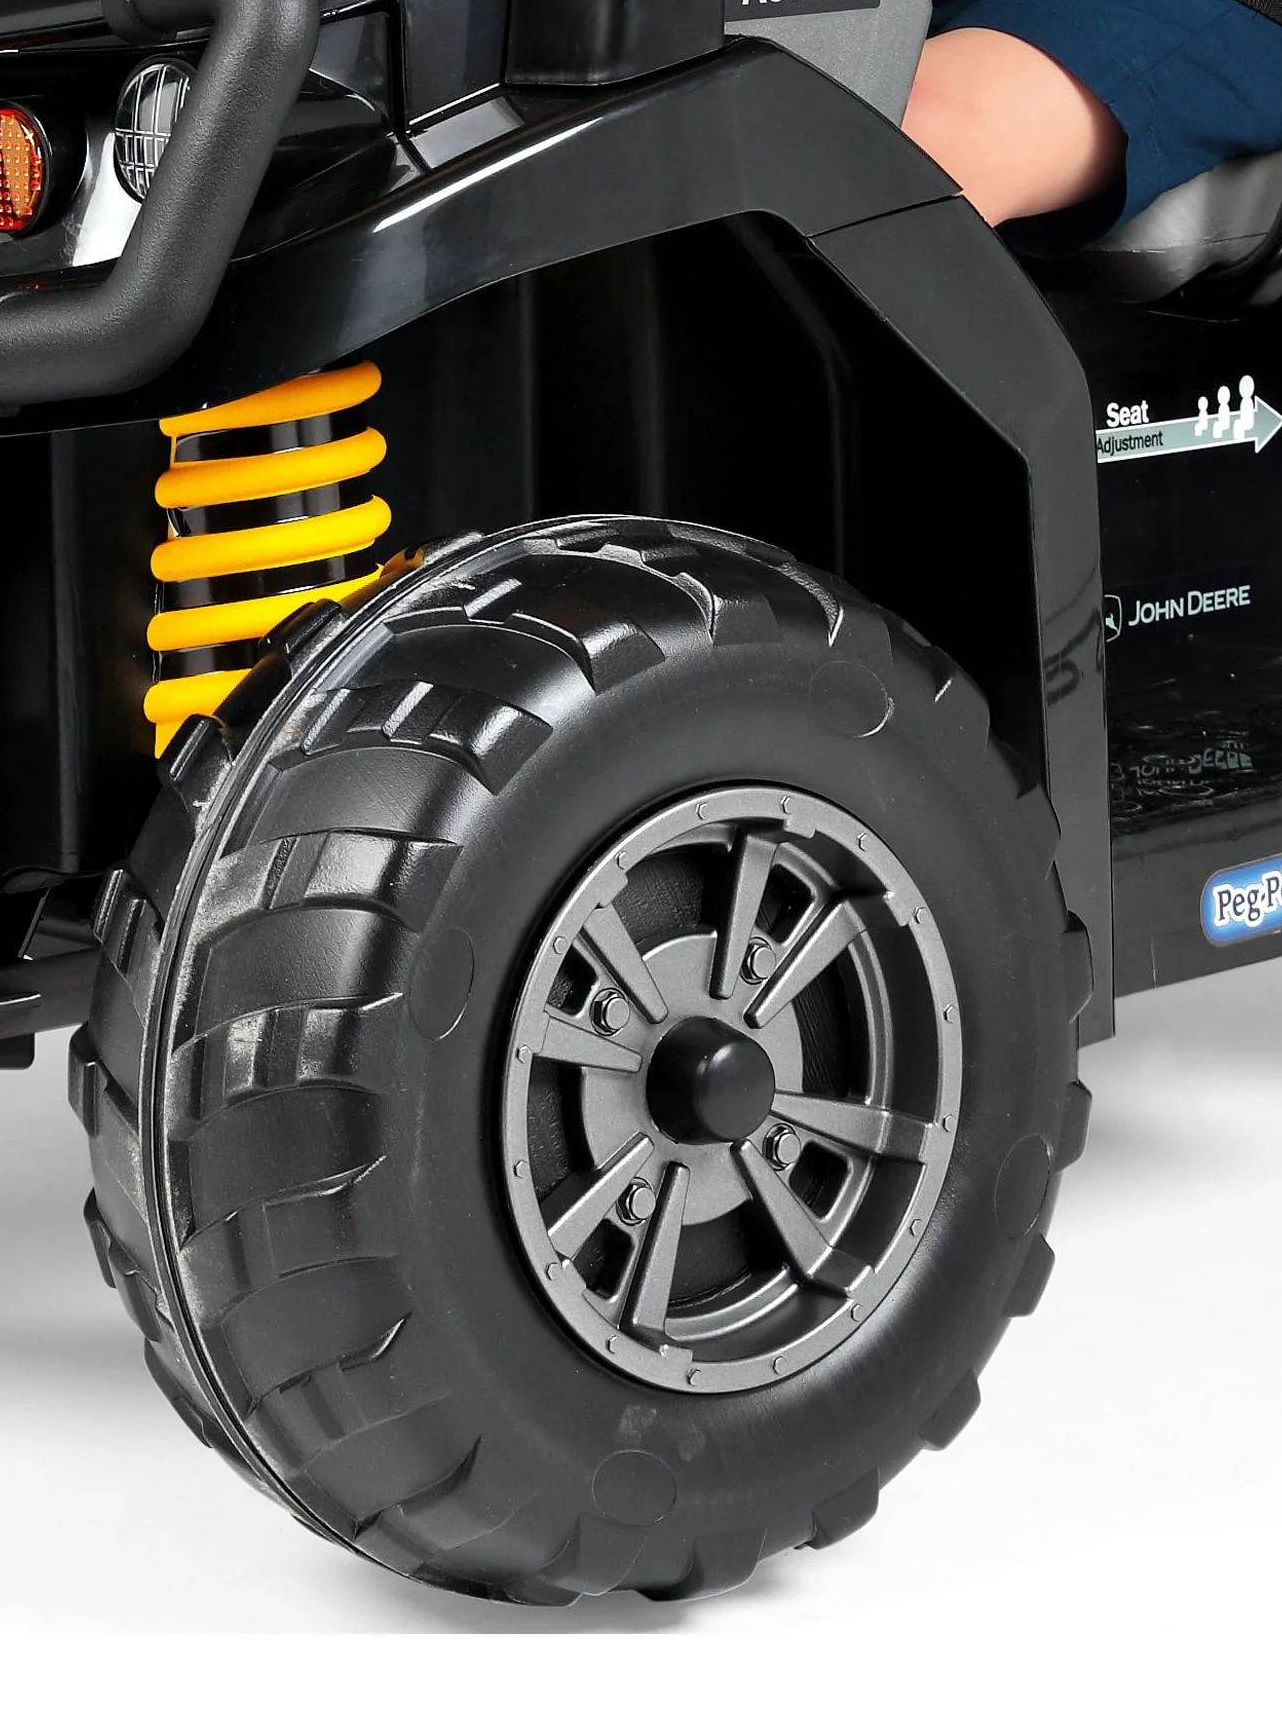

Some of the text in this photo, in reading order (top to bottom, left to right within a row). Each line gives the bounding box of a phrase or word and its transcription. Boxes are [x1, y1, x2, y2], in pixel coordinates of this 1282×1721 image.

[1106, 400, 1150, 428] Seat
[1097, 430, 1164, 456] Adjustment
[1128, 584, 1251, 627] JOHN DEERE
